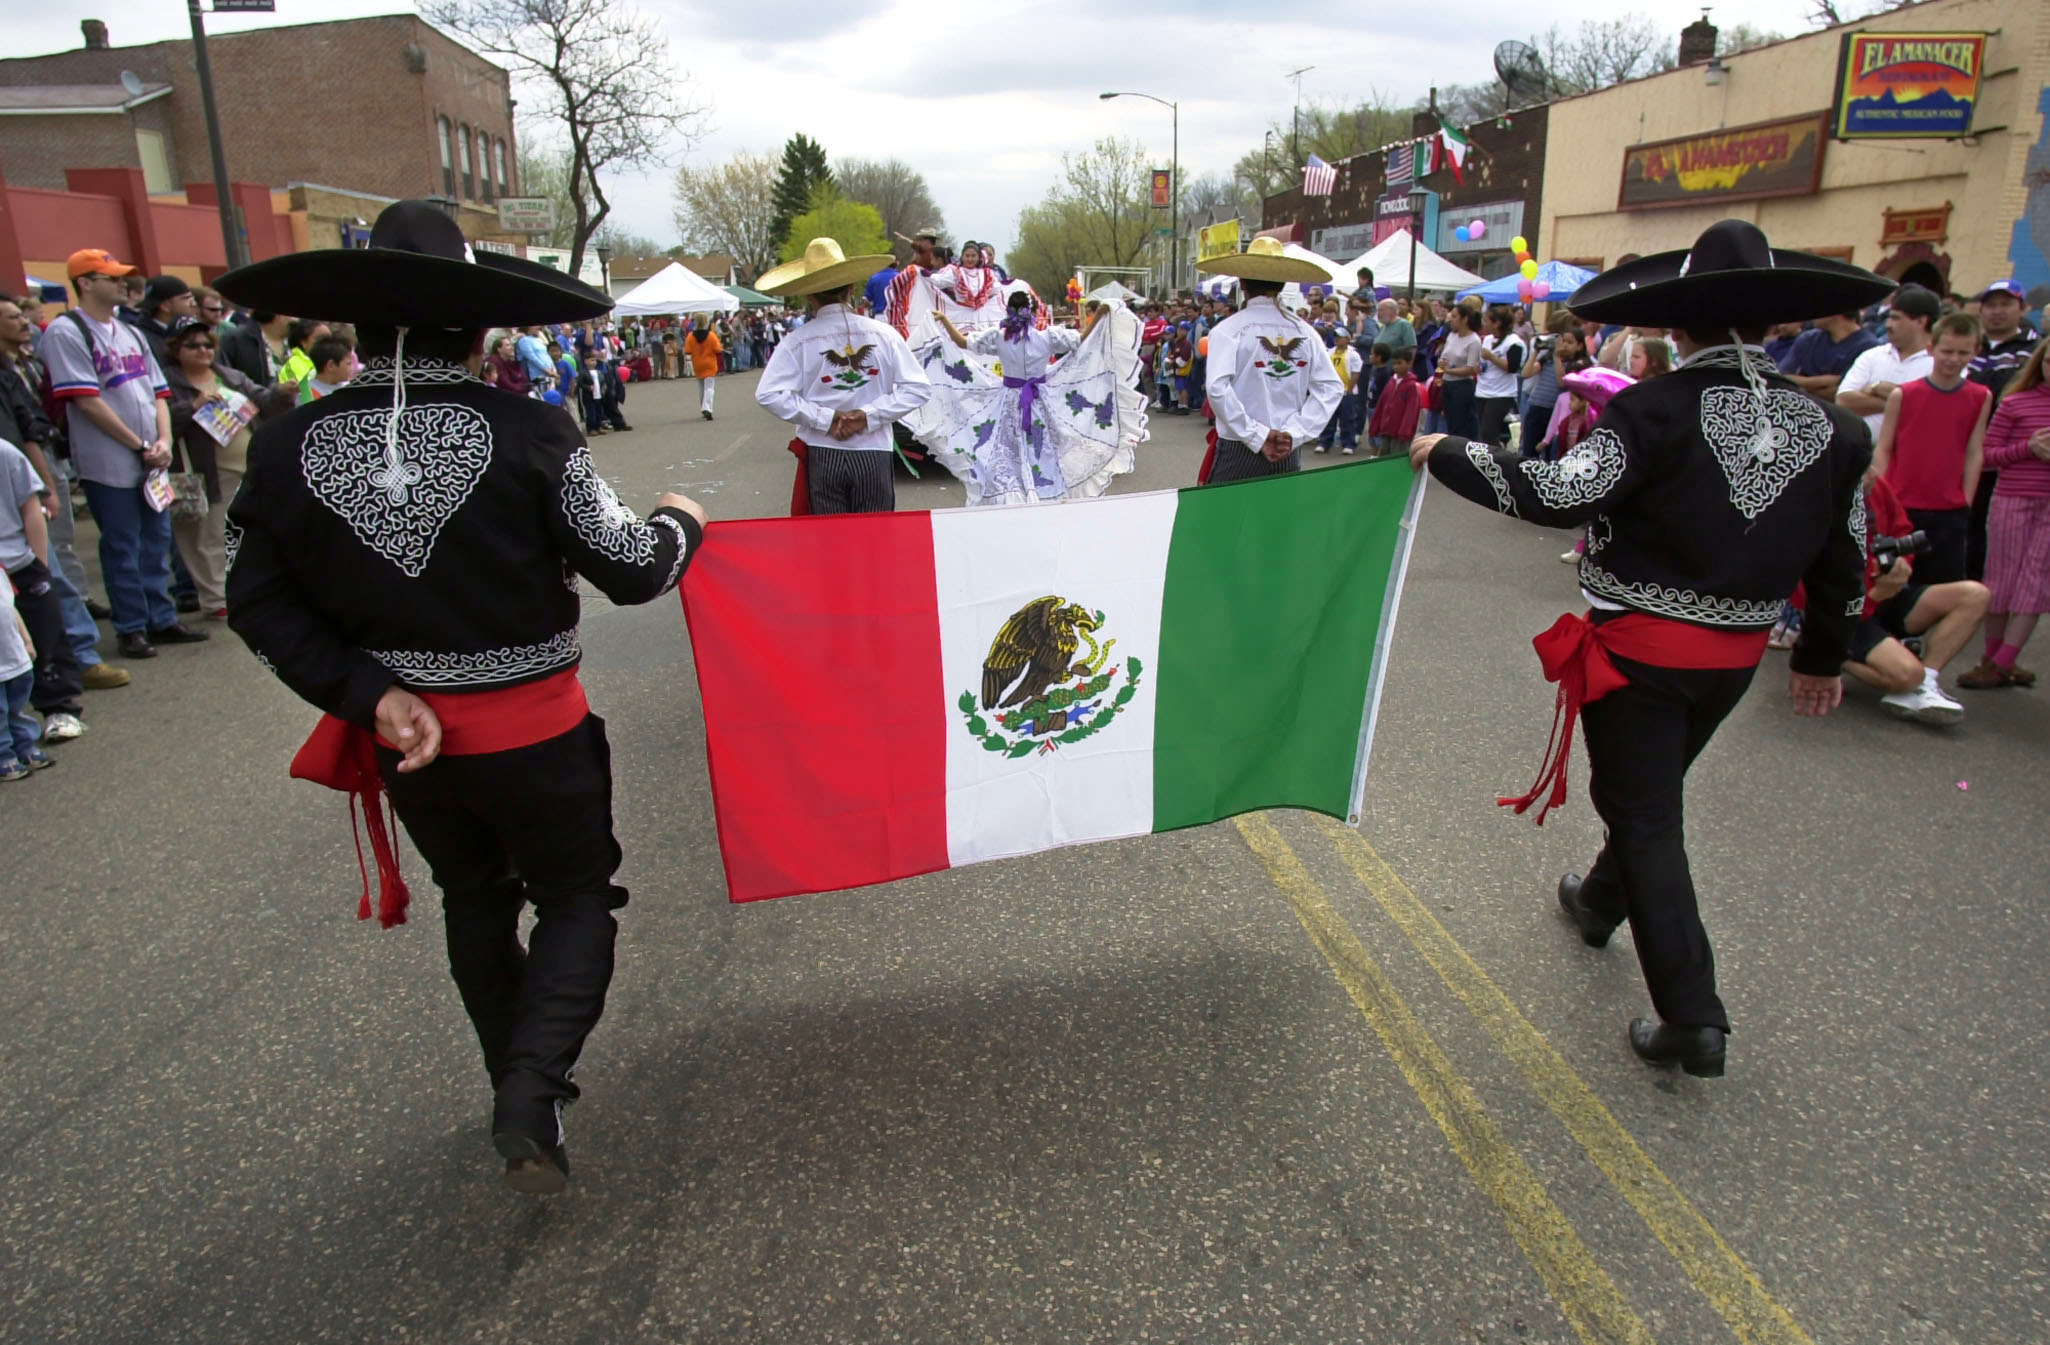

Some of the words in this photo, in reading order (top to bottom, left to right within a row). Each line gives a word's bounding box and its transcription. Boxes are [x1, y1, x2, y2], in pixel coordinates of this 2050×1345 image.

[1860, 42, 1888, 77] EL
[1901, 109, 1938, 119] MEXICAN
[1938, 109, 1963, 119] FOOD
